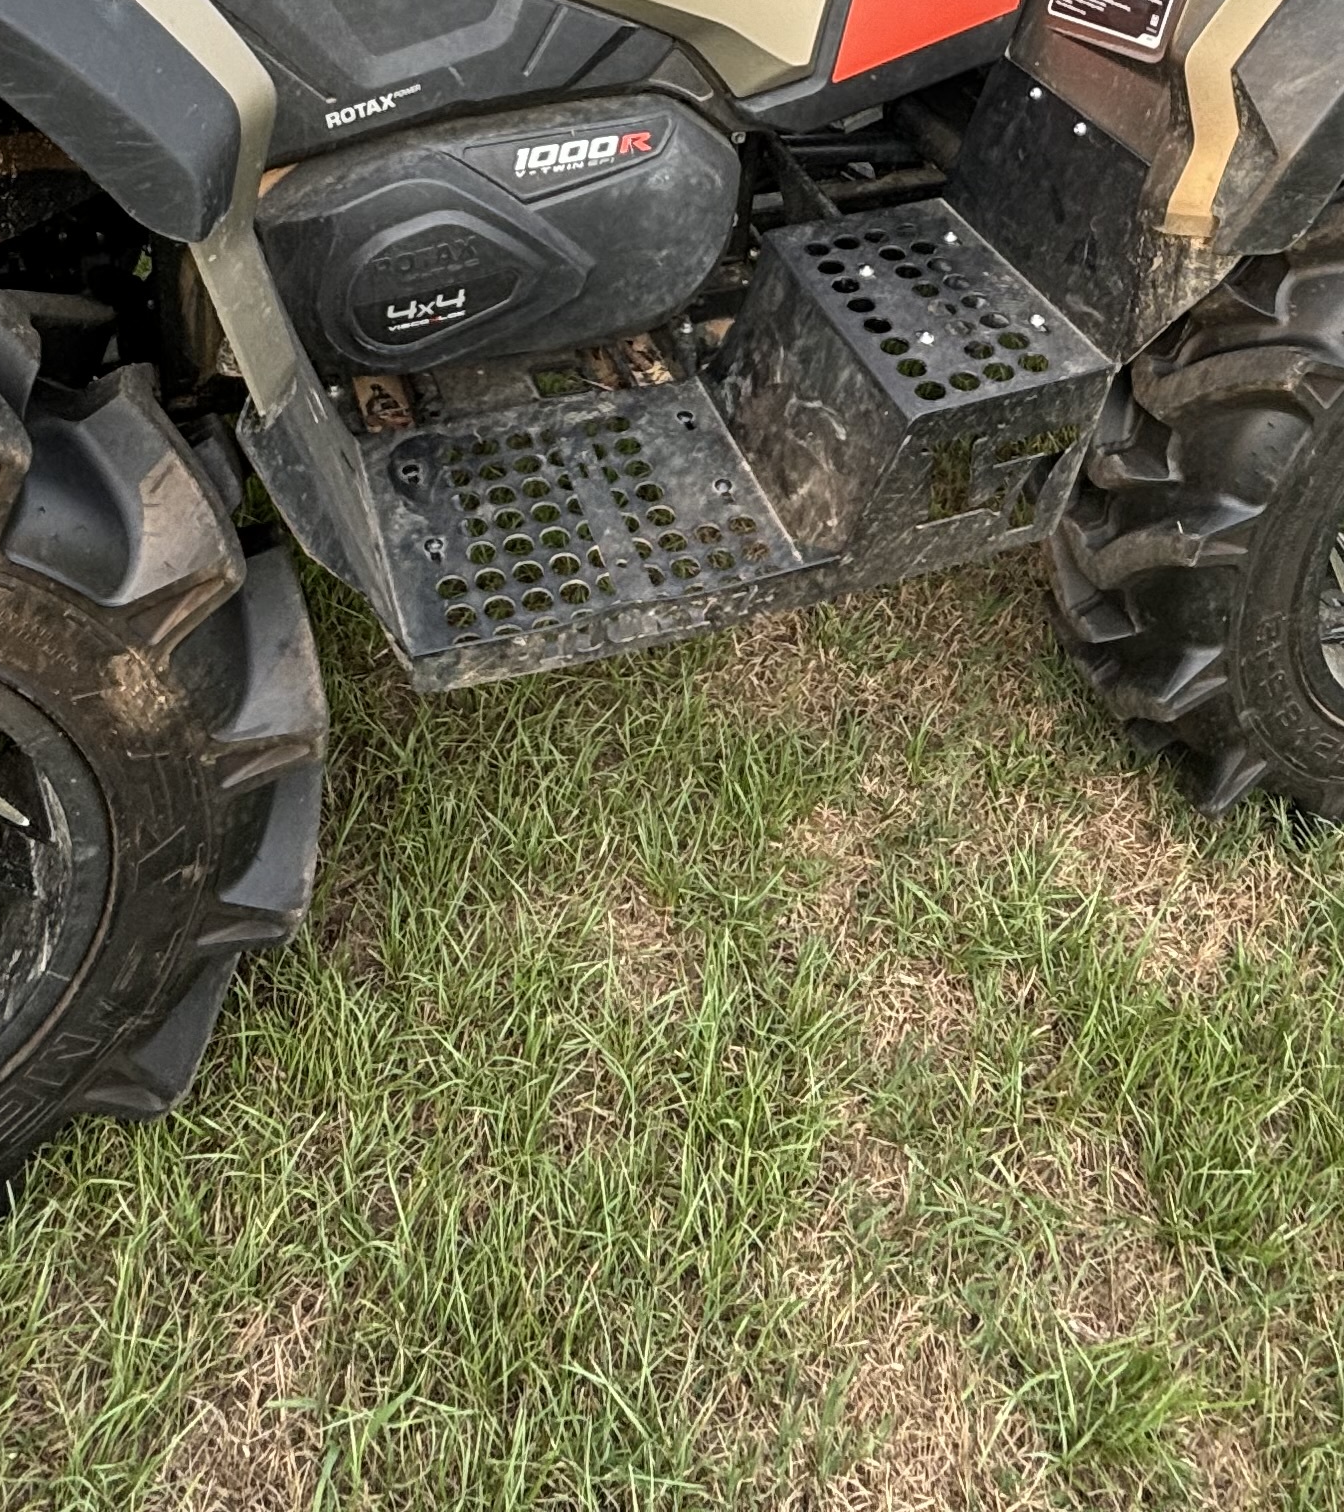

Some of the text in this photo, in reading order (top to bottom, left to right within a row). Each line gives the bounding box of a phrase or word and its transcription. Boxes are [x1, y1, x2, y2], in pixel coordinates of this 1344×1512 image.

[324, 92, 397, 129] ROTAX
[514, 131, 653, 171] 1000R
[386, 288, 467, 320] 4x4
